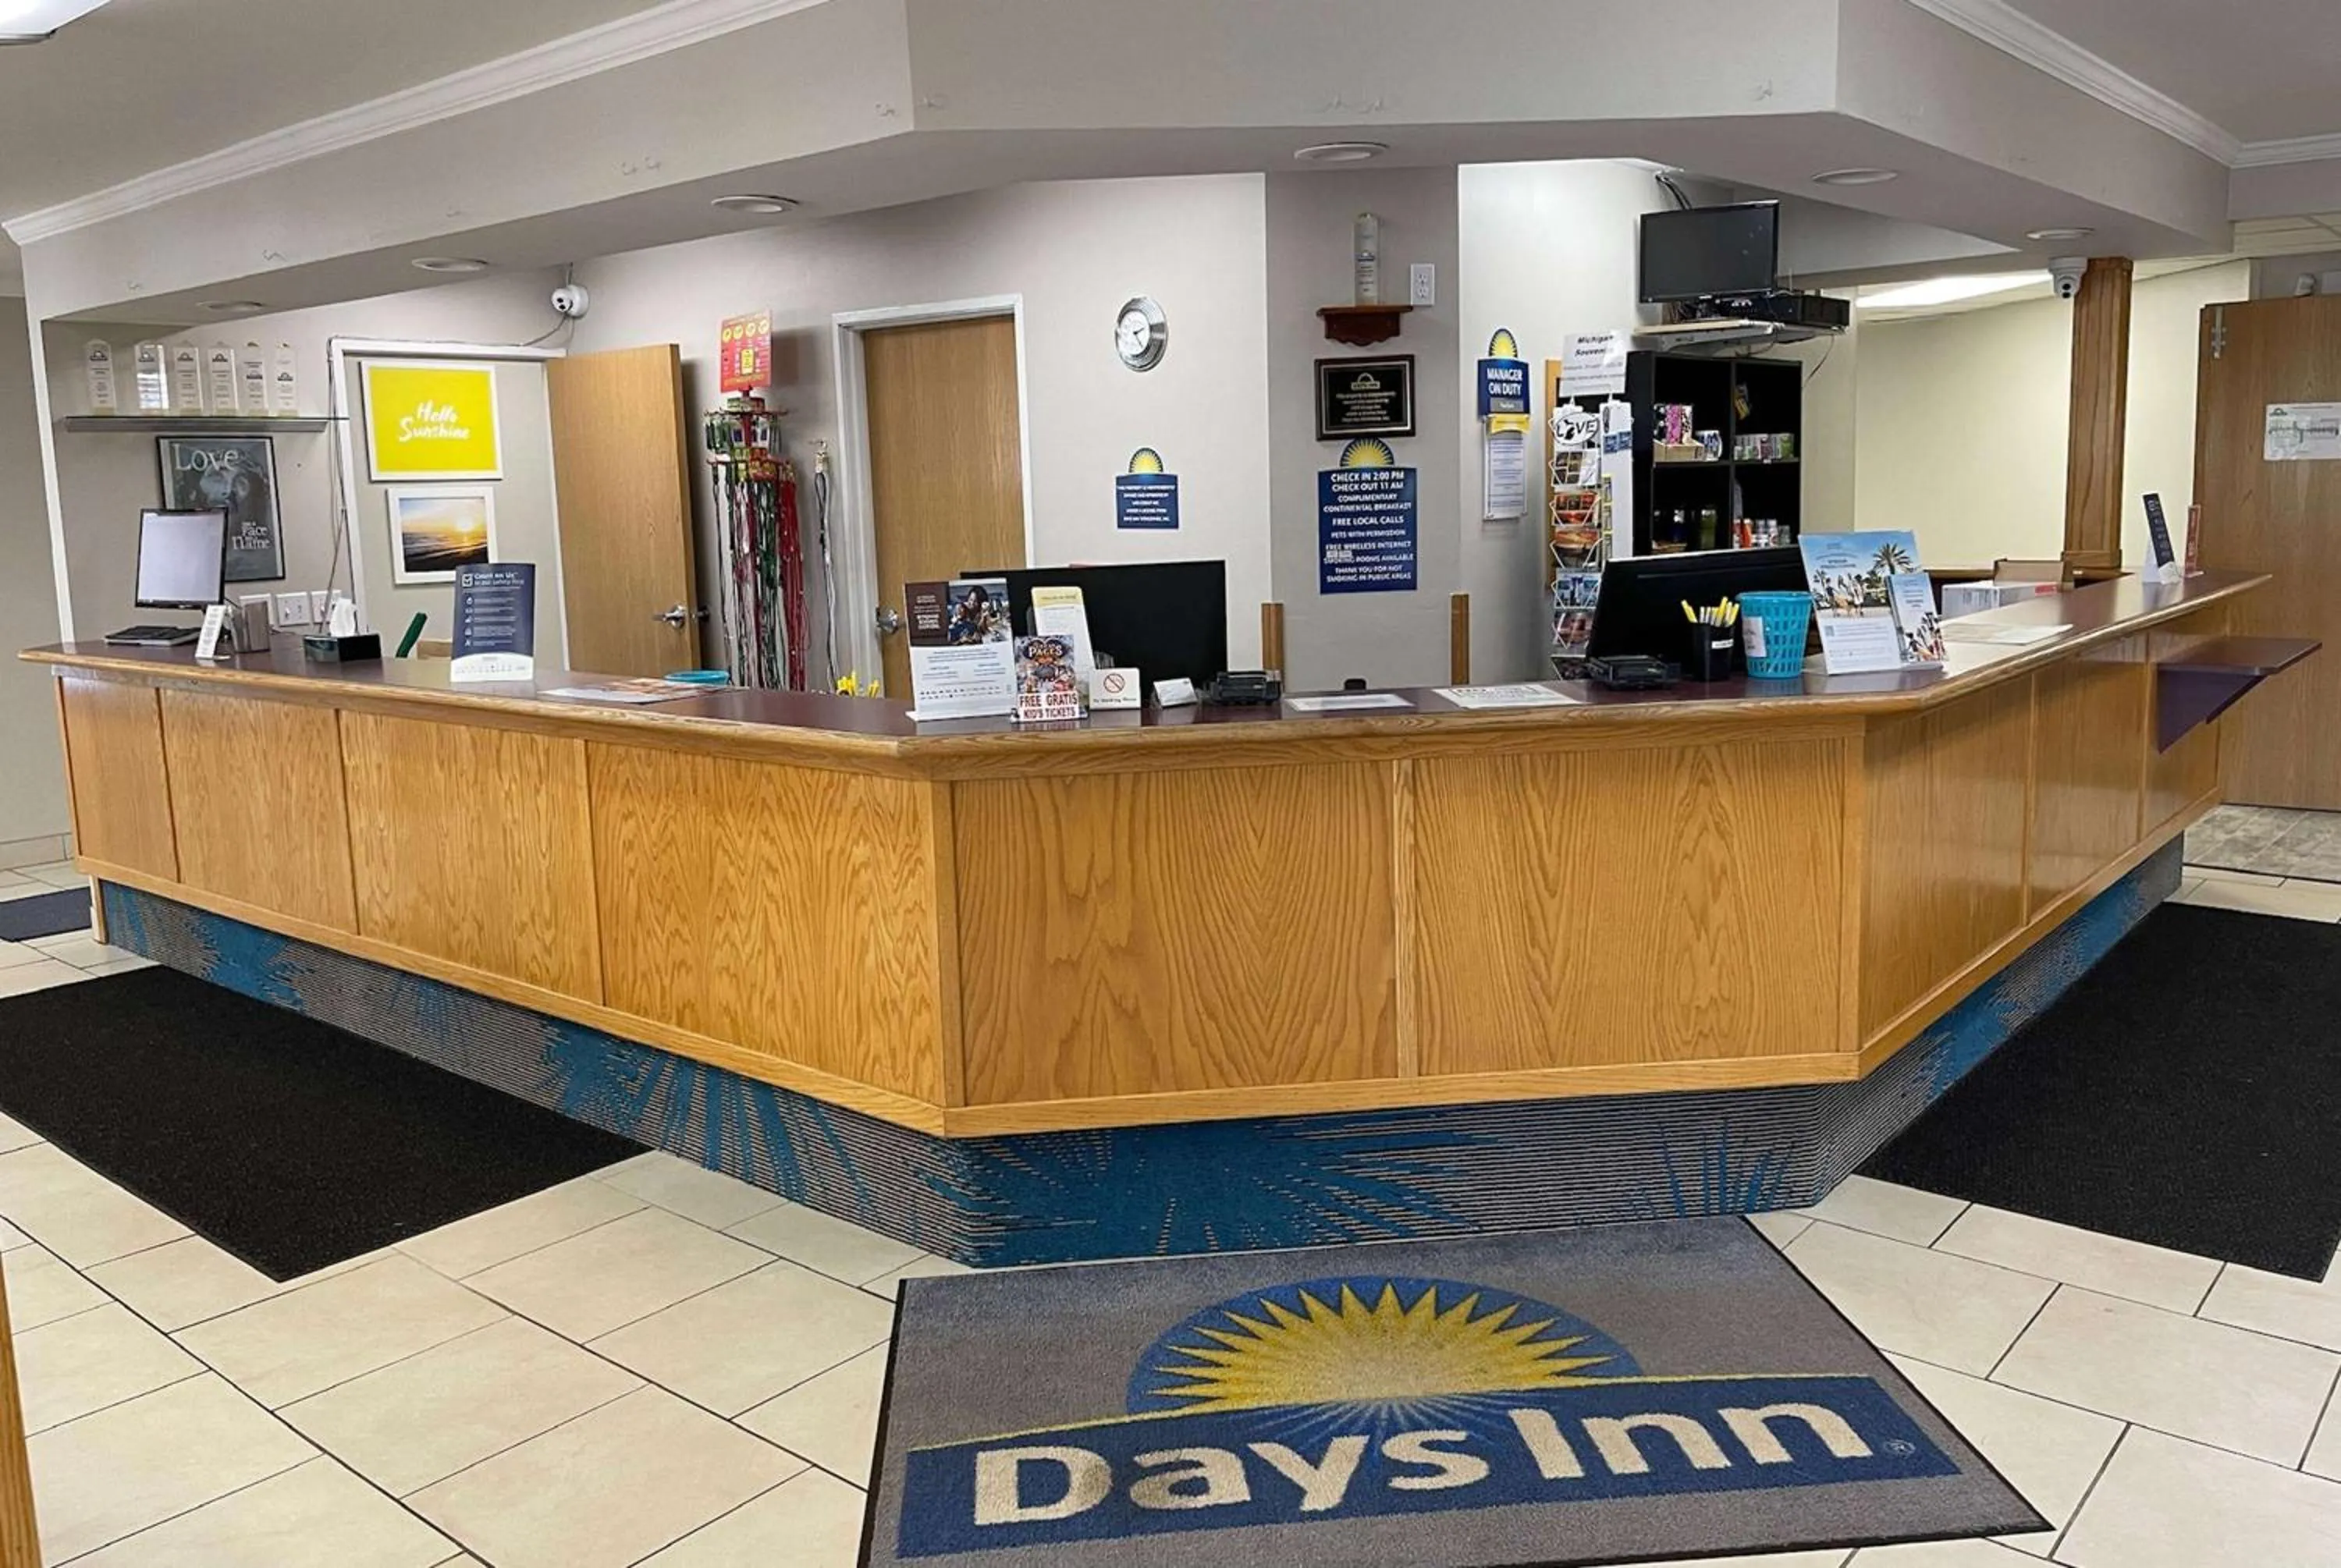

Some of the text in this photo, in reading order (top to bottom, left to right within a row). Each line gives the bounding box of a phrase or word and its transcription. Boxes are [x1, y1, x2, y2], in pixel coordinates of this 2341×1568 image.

[1487, 368, 1523, 381] MANAGER
[1488, 383, 1522, 396] ON DUTY
[417, 399, 458, 423] Hello
[399, 415, 471, 443] Sunshine
[172, 443, 239, 471] Love
[1330, 470, 1405, 482] CHECK IN 2:00 PM
[1332, 482, 1359, 492] CHECK
[1360, 482, 1379, 491] OUT
[1380, 481, 1388, 490] 11
[1337, 493, 1398, 502] COMPLIMENTARY
[1323, 502, 1412, 513] CONTINENTAL BREAKFAST
[1332, 516, 1405, 526] FREE LOCAL CALLS
[1019, 693, 1078, 707] FREE GRATIS
[1024, 708, 1075, 719] KID'S TICKETS
[975, 1402, 1873, 1526] Days Inn
